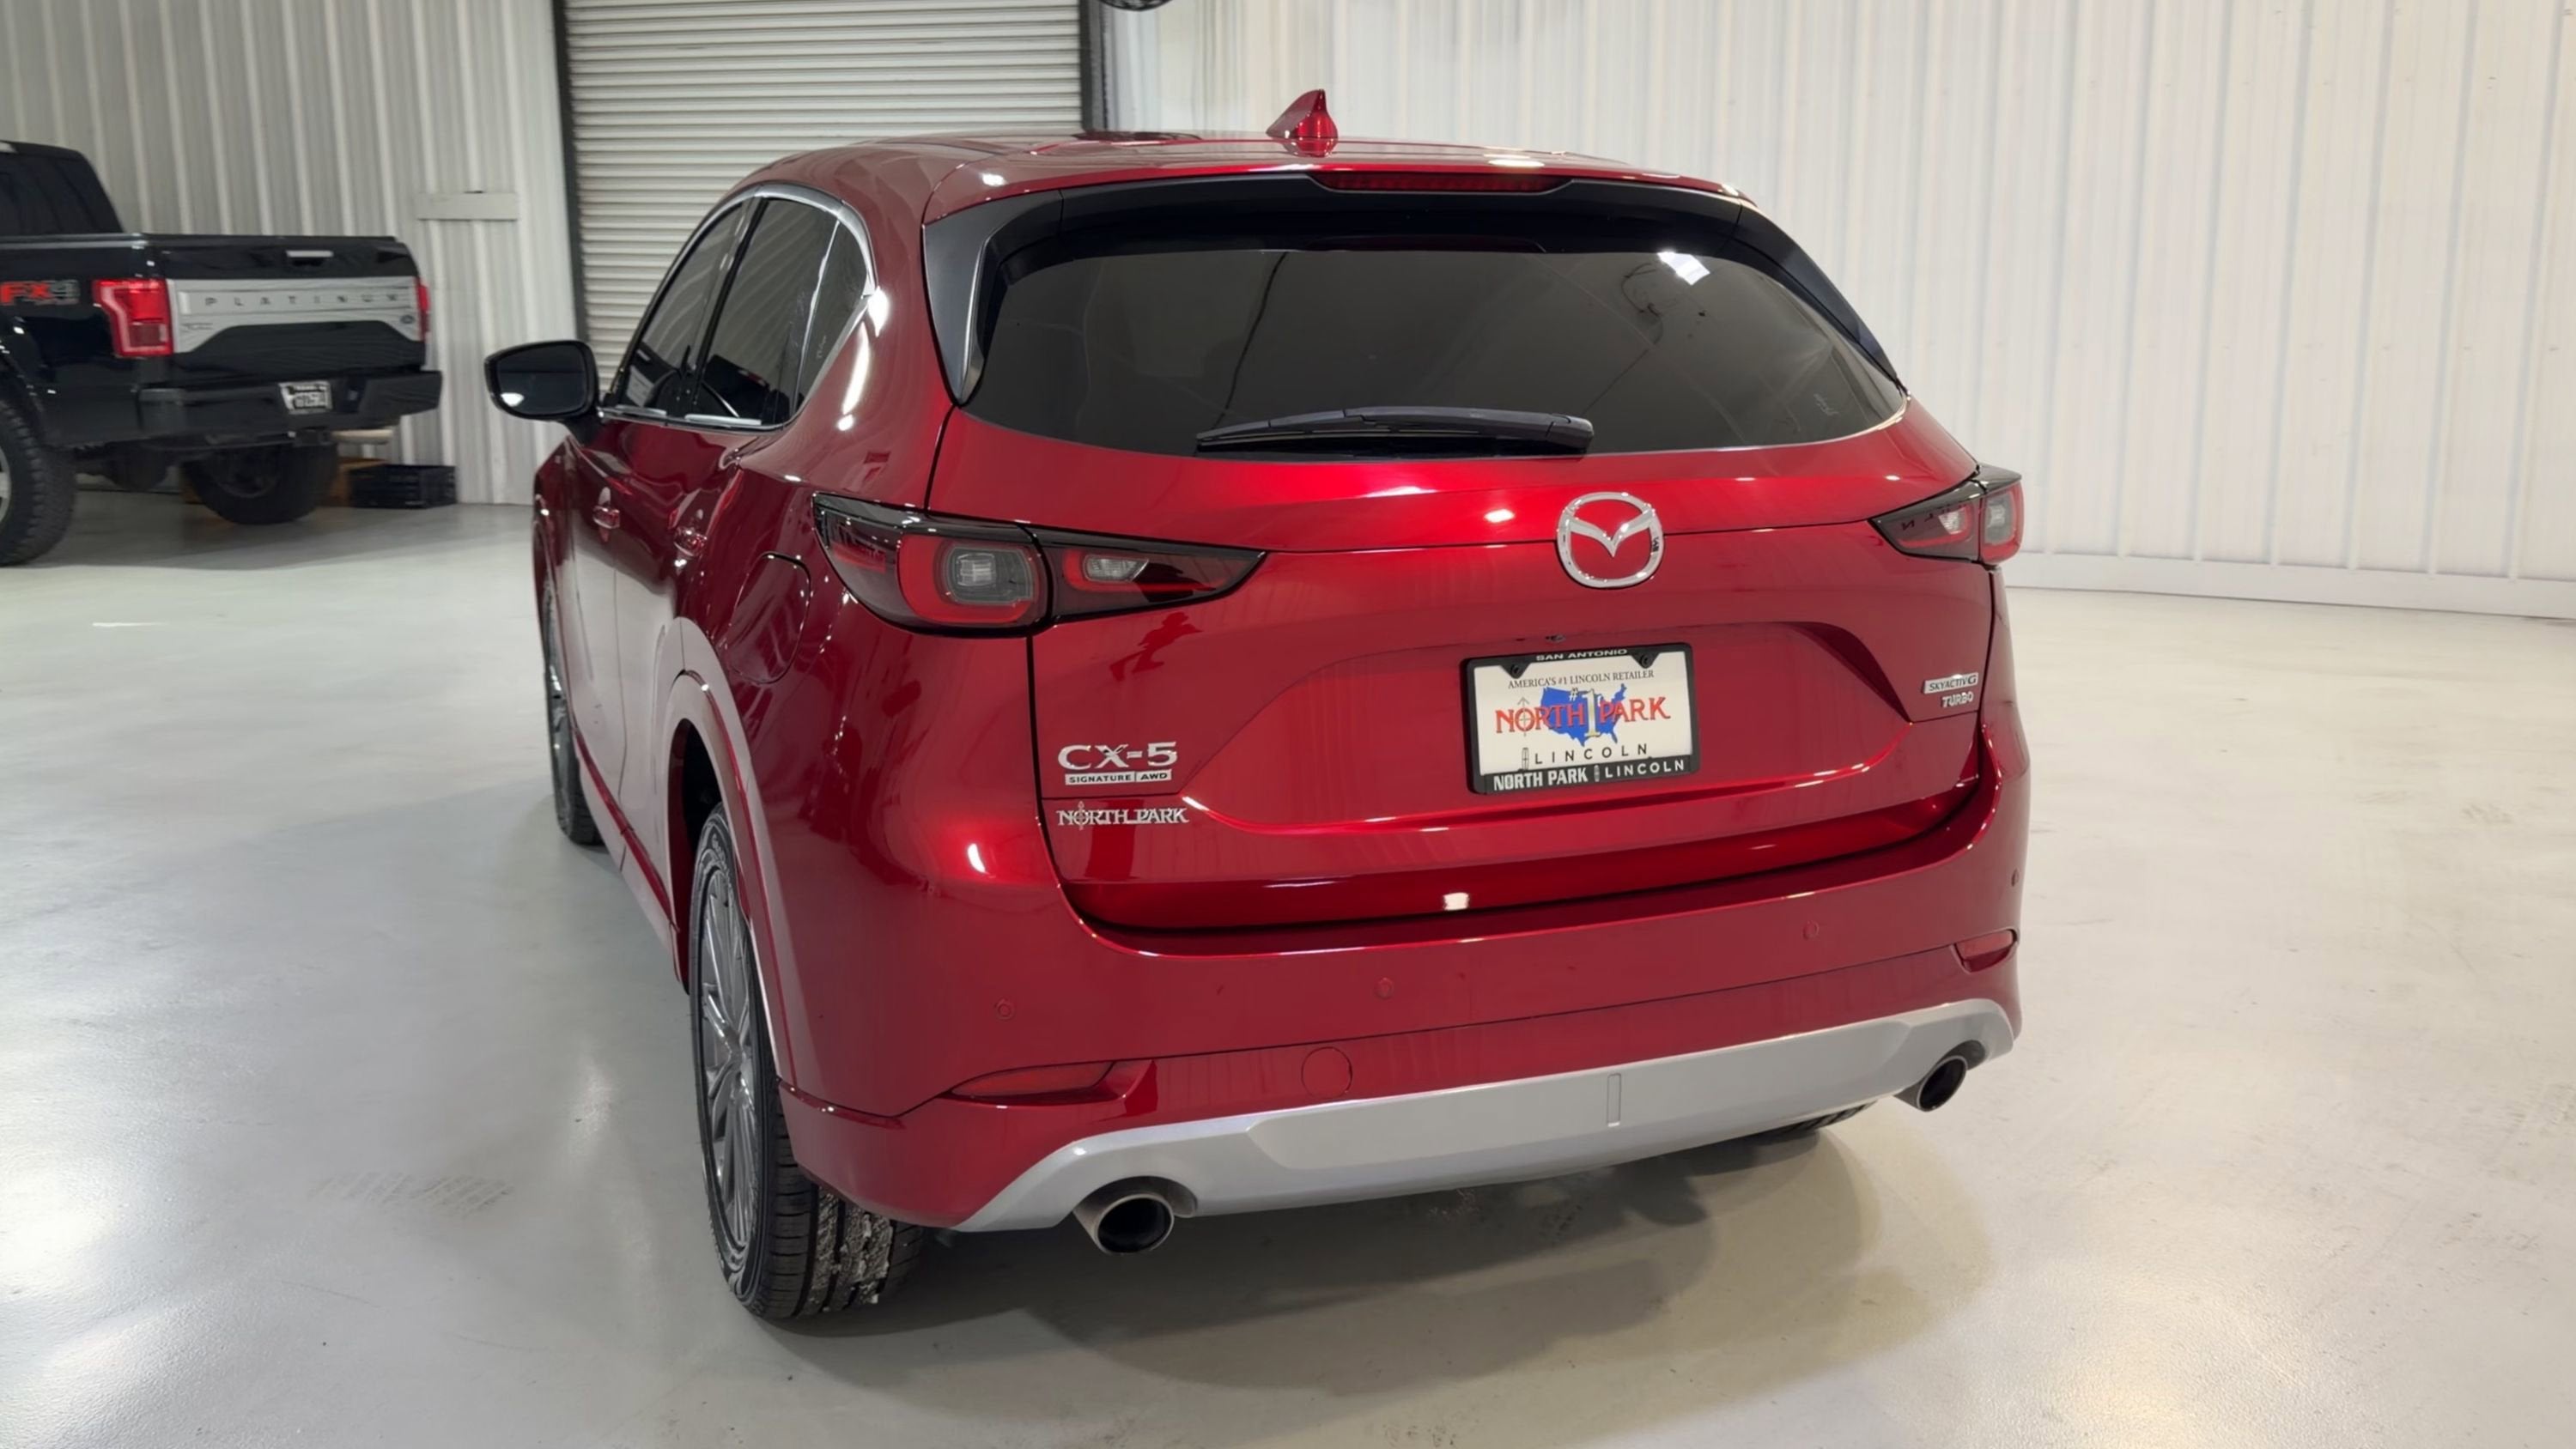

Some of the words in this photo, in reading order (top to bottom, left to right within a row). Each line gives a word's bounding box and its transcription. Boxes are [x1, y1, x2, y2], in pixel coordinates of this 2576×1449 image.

[204, 294, 398, 306] PLATINUM
[1535, 652, 1564, 662] SAN
[1567, 648, 1628, 659] ANTONIO
[1508, 676, 1558, 689] AMERICA'S
[1570, 673, 1612, 684] LINCOLN
[1613, 670, 1655, 681] RETAILER
[1941, 691, 1974, 708] TURBO
[1495, 700, 1586, 734] NORTH
[1599, 696, 1671, 724] PARK
[1057, 741, 1178, 770] CX-5
[1534, 743, 1648, 765] LINCOLN
[1069, 774, 1132, 784] SIGNATURE
[1140, 772, 1168, 780] AWD
[1493, 771, 1544, 791] NORTH
[1547, 767, 1588, 786] PARK
[1605, 759, 1686, 779] LINCOLN
